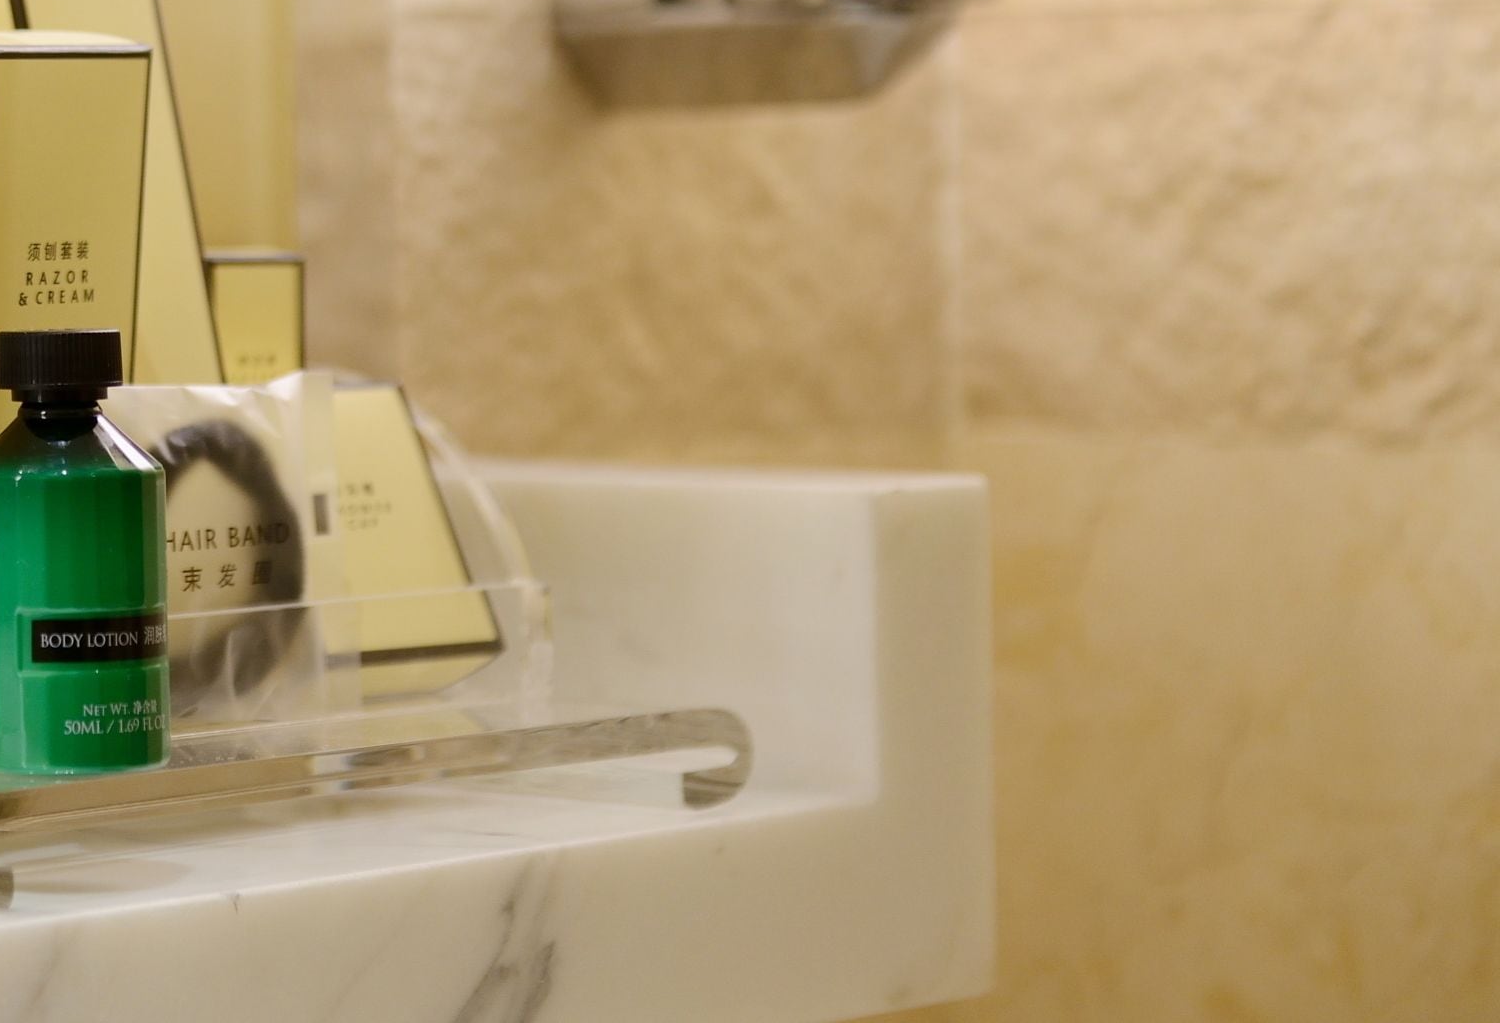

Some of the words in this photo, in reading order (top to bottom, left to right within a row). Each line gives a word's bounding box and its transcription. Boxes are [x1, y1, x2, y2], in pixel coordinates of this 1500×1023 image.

[27, 240, 89, 262] 须刨套装
[25, 269, 89, 286] RAZOR
[18, 292, 28, 306] &
[35, 288, 95, 305] CREAM
[166, 528, 218, 552] HAIR
[227, 521, 290, 549] BAND
[40, 632, 83, 648] BODY
[87, 631, 139, 648] LOTION
[64, 719, 104, 735] 50ML
[106, 719, 115, 734] /
[119, 718, 140, 733] 1.69
